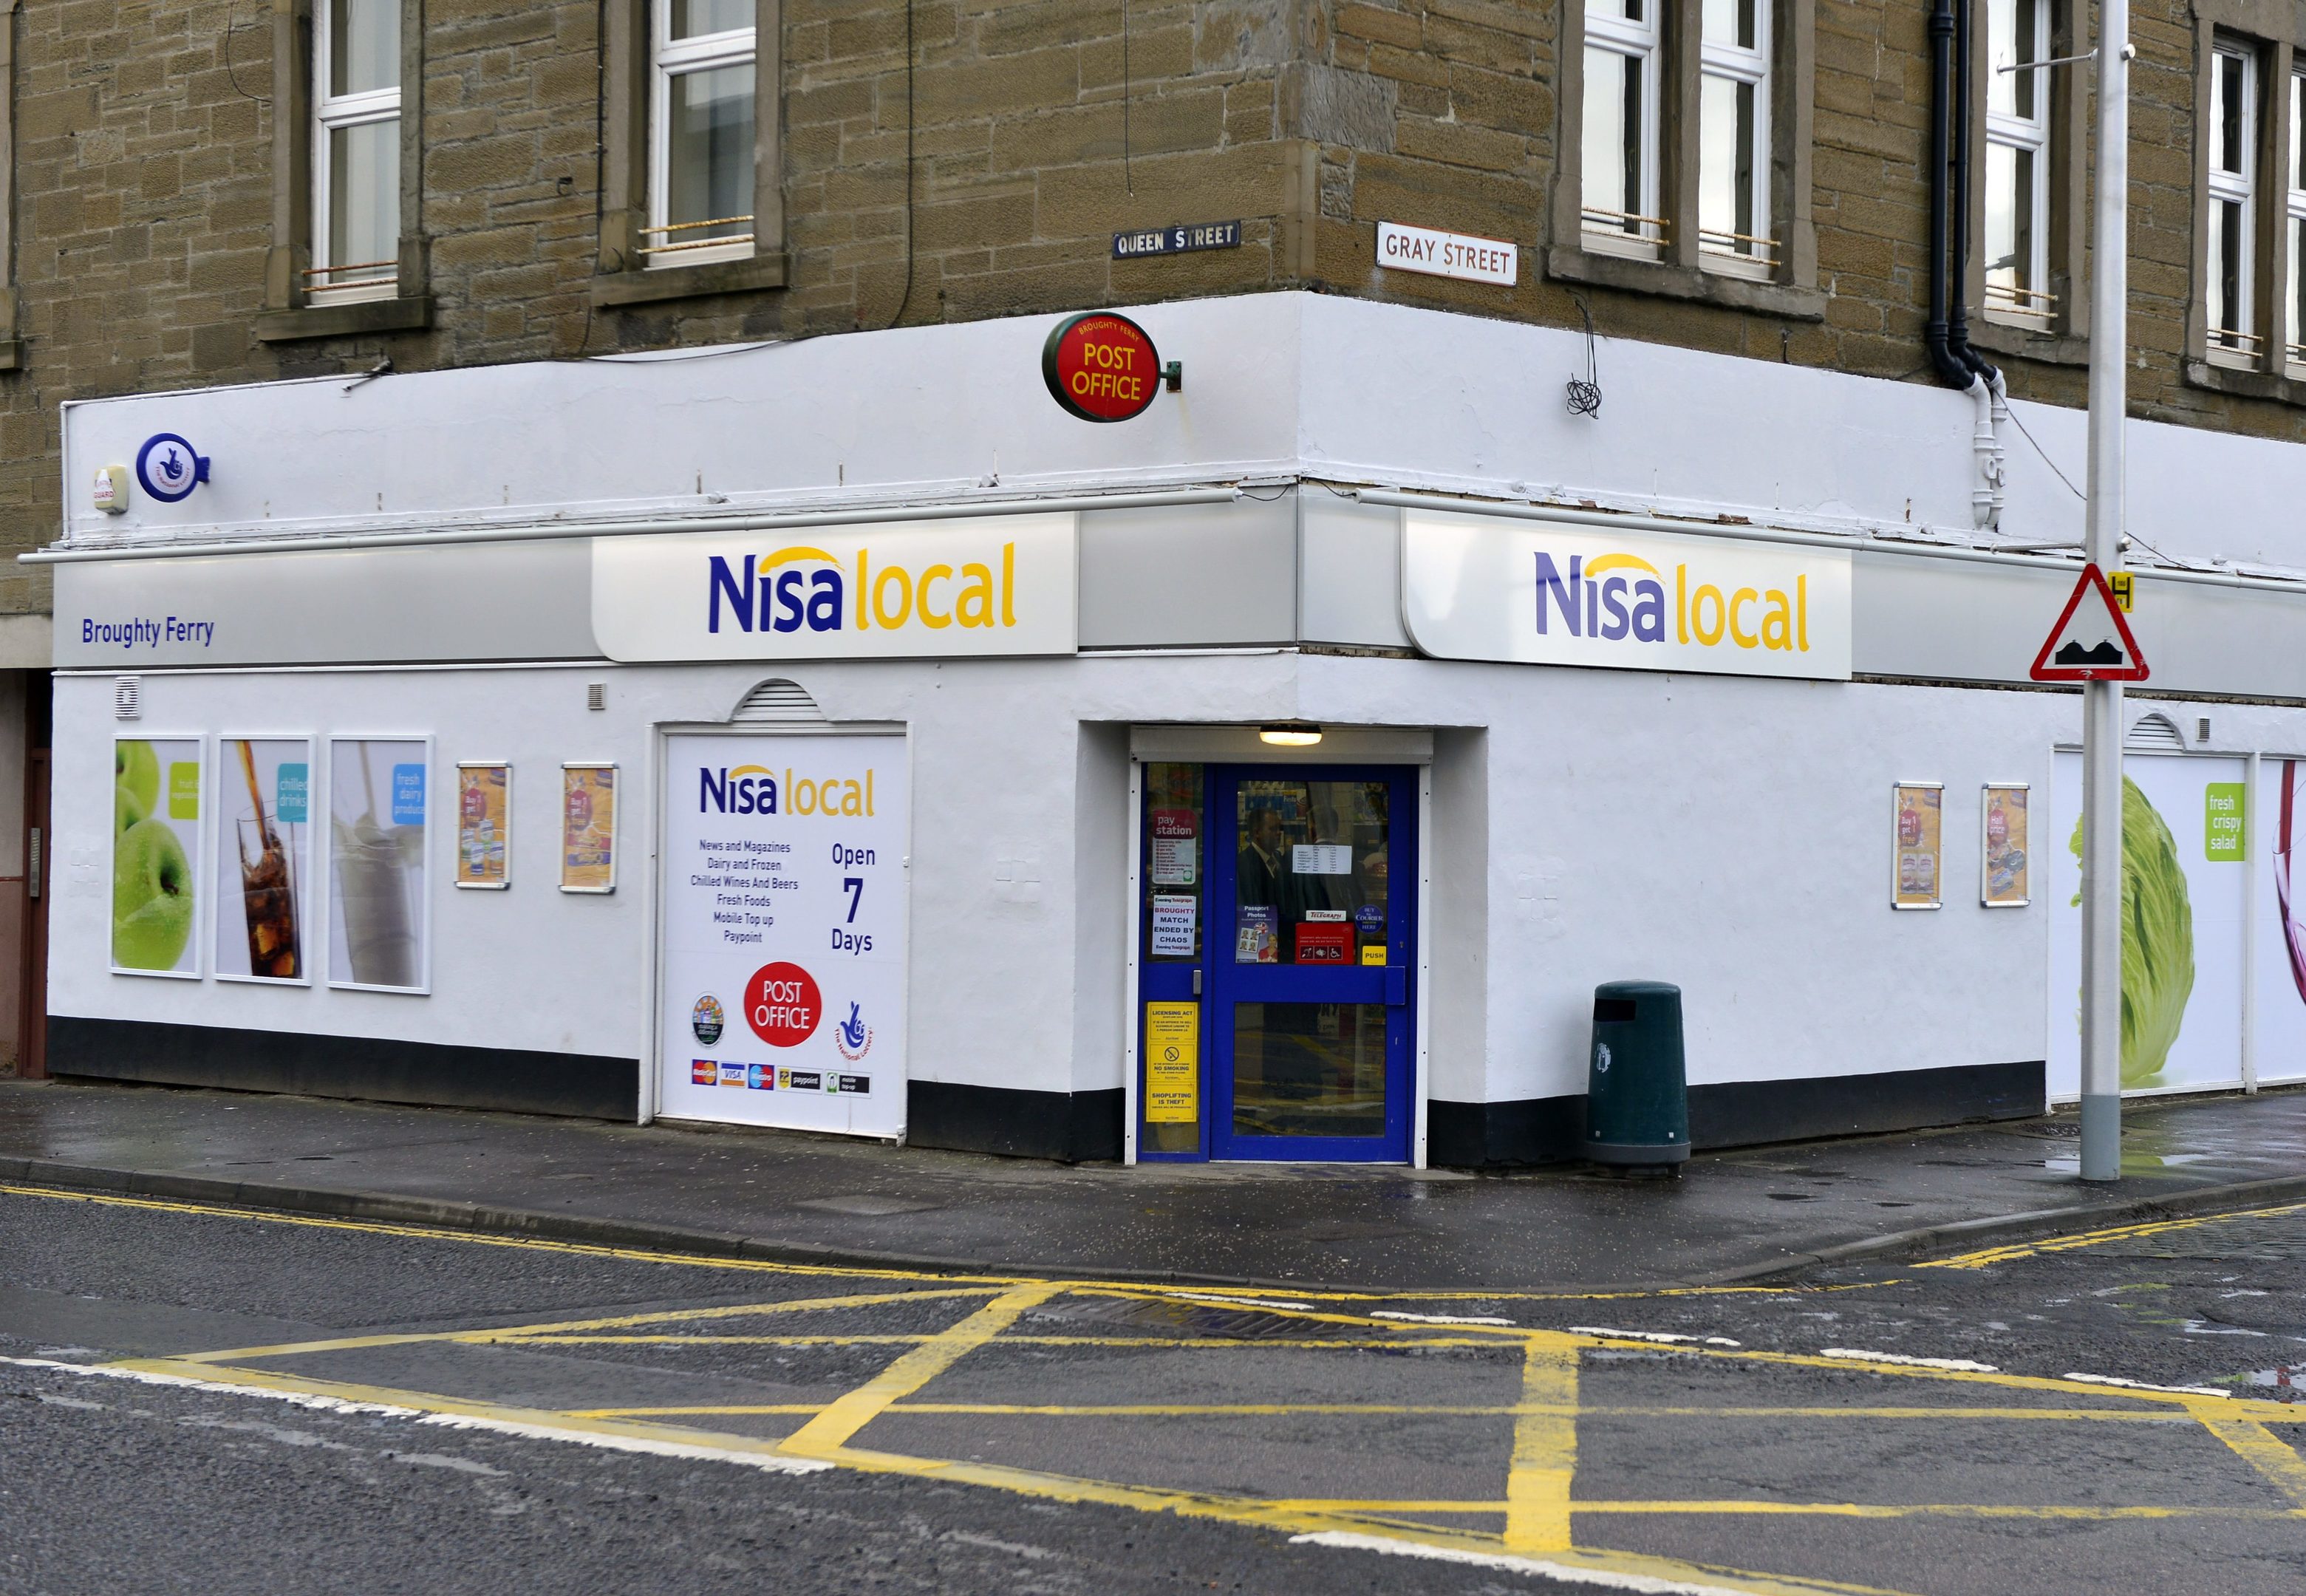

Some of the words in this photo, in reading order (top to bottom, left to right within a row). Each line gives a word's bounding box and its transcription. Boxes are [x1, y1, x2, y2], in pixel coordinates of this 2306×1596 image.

[1118, 233, 1164, 254] QUEEN
[1175, 225, 1233, 248] STREET
[1386, 233, 1436, 262] GRAY
[1444, 242, 1510, 274] STREET
[1078, 321, 1118, 335] BROUGHTY
[1119, 325, 1140, 342] FERRY
[1084, 343, 1136, 371] POST
[1072, 371, 1142, 400] OFFICE
[709, 547, 844, 633] Nisa
[855, 542, 1017, 631] local
[1533, 551, 1665, 643] Nisa
[1676, 563, 1810, 652] local
[83, 617, 161, 649] Broughty
[166, 616, 214, 647] Ferry
[397, 773, 420, 785] fresh
[400, 788, 422, 803] dairy
[699, 765, 778, 815] Nisa
[785, 768, 874, 817] local
[2209, 794, 2234, 811] fresh
[1158, 816, 1175, 826] pay
[1991, 816, 2004, 825] Half
[2213, 813, 2242, 833] crispy
[1156, 825, 1192, 836] station
[1989, 825, 2005, 836] price
[700, 839, 723, 851] News
[726, 840, 742, 851] and
[744, 840, 791, 855] Magazines
[1902, 835, 1916, 845] free
[2211, 834, 2237, 850] salad
[708, 857, 731, 871] Dairy
[732, 859, 748, 870] and
[751, 859, 782, 871] Frozen
[832, 842, 876, 870] Open
[691, 875, 721, 887] Chilled
[723, 876, 750, 887] Wines
[751, 877, 769, 889] And
[771, 877, 799, 890] Beers
[717, 893, 742, 906] Fresh
[744, 894, 771, 907] Foods
[843, 877, 864, 924] 7
[713, 911, 743, 924] Mobile
[745, 913, 760, 927] Top
[762, 915, 774, 928] up
[724, 930, 763, 944] Paypoint
[832, 928, 873, 956] Days
[763, 980, 803, 1003] POST
[754, 1005, 810, 1029] OFFICE
[838, 1043, 861, 1060] National
[724, 1070, 741, 1080] VISA
